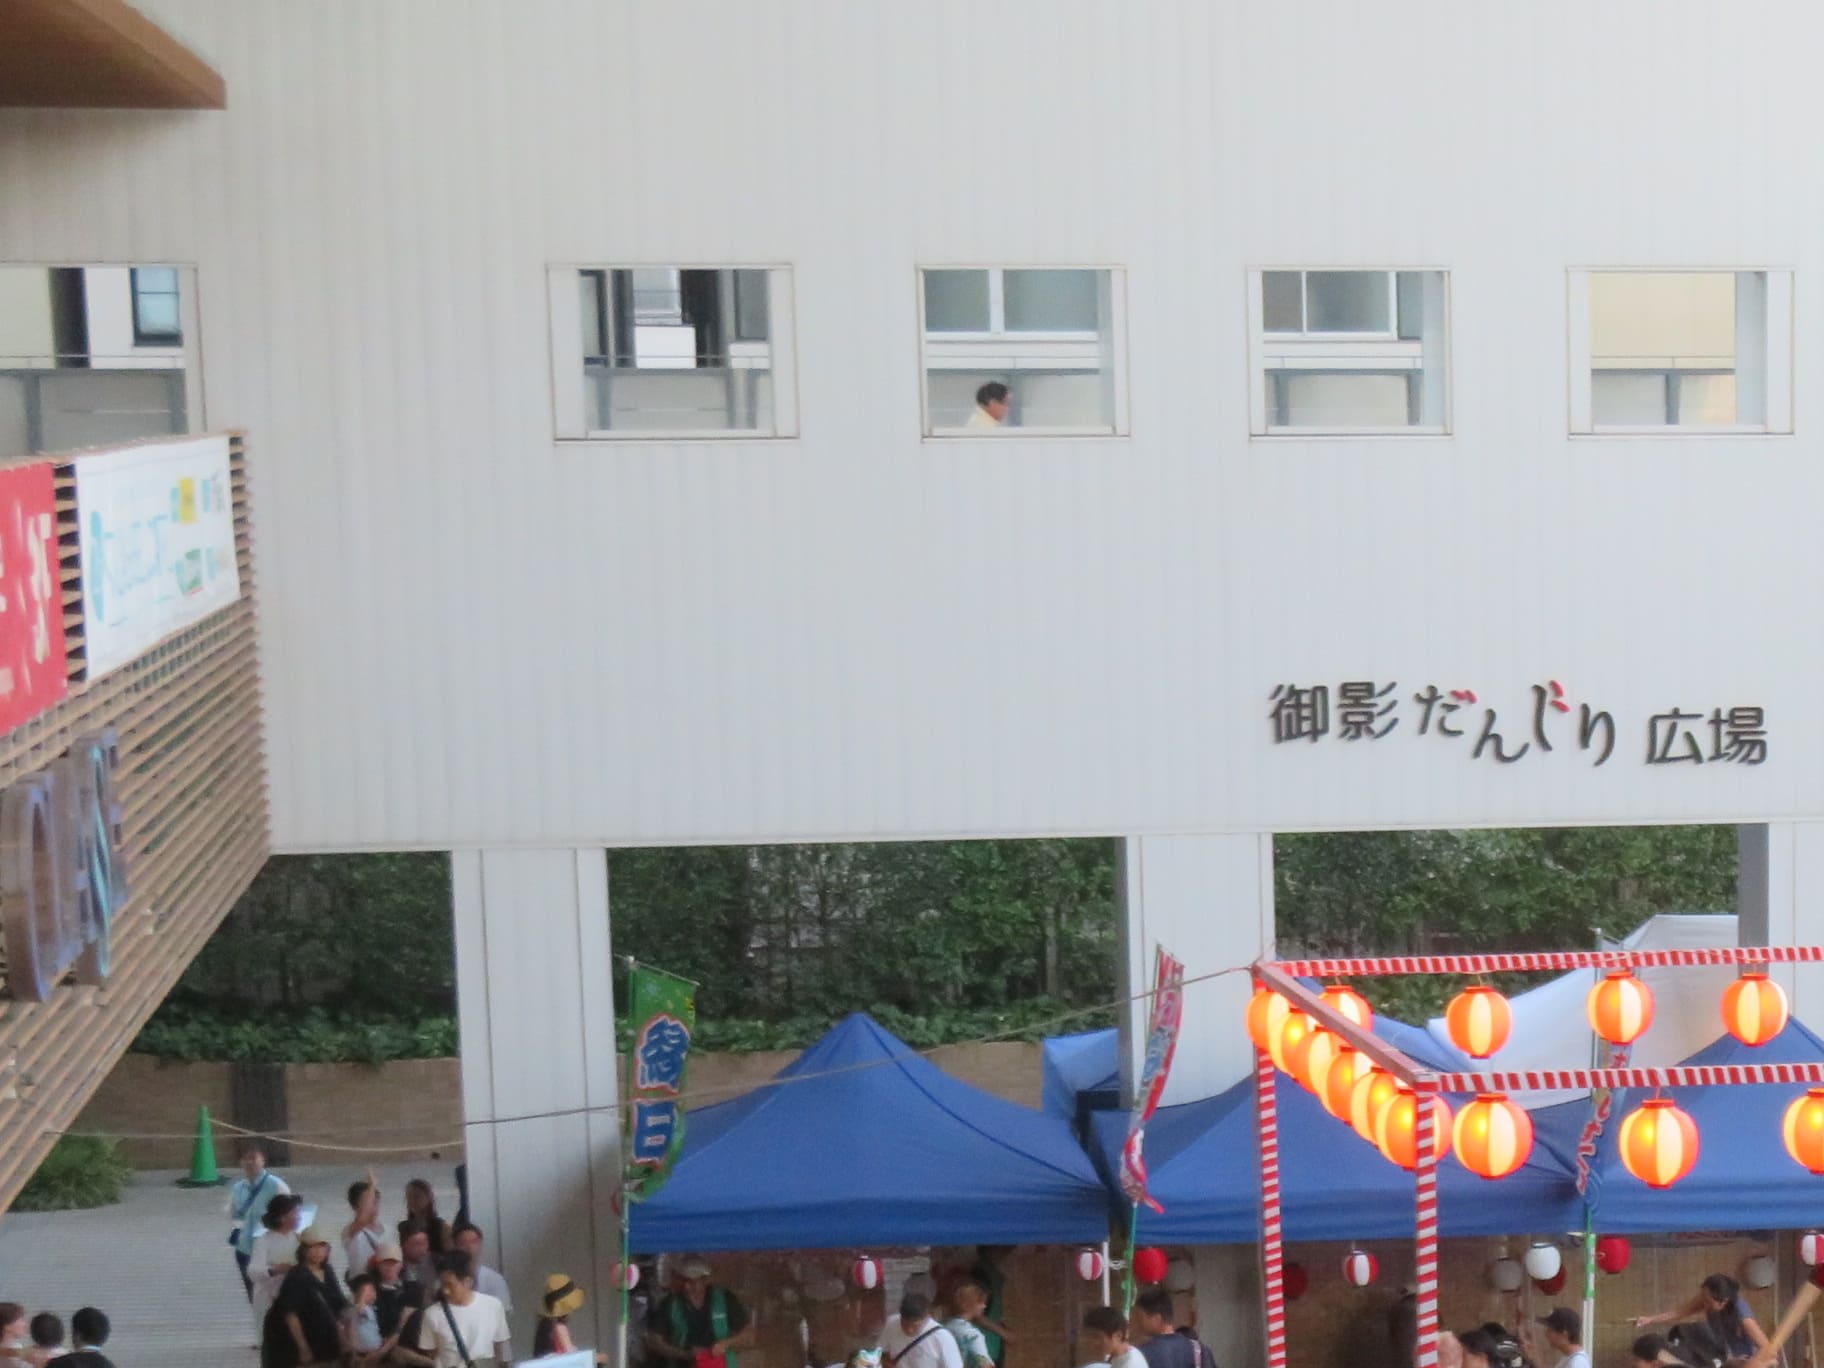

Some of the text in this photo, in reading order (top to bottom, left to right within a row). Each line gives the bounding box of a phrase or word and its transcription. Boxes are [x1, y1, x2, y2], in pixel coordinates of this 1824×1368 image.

[1268, 680, 1769, 767] 御影だんじり広場
